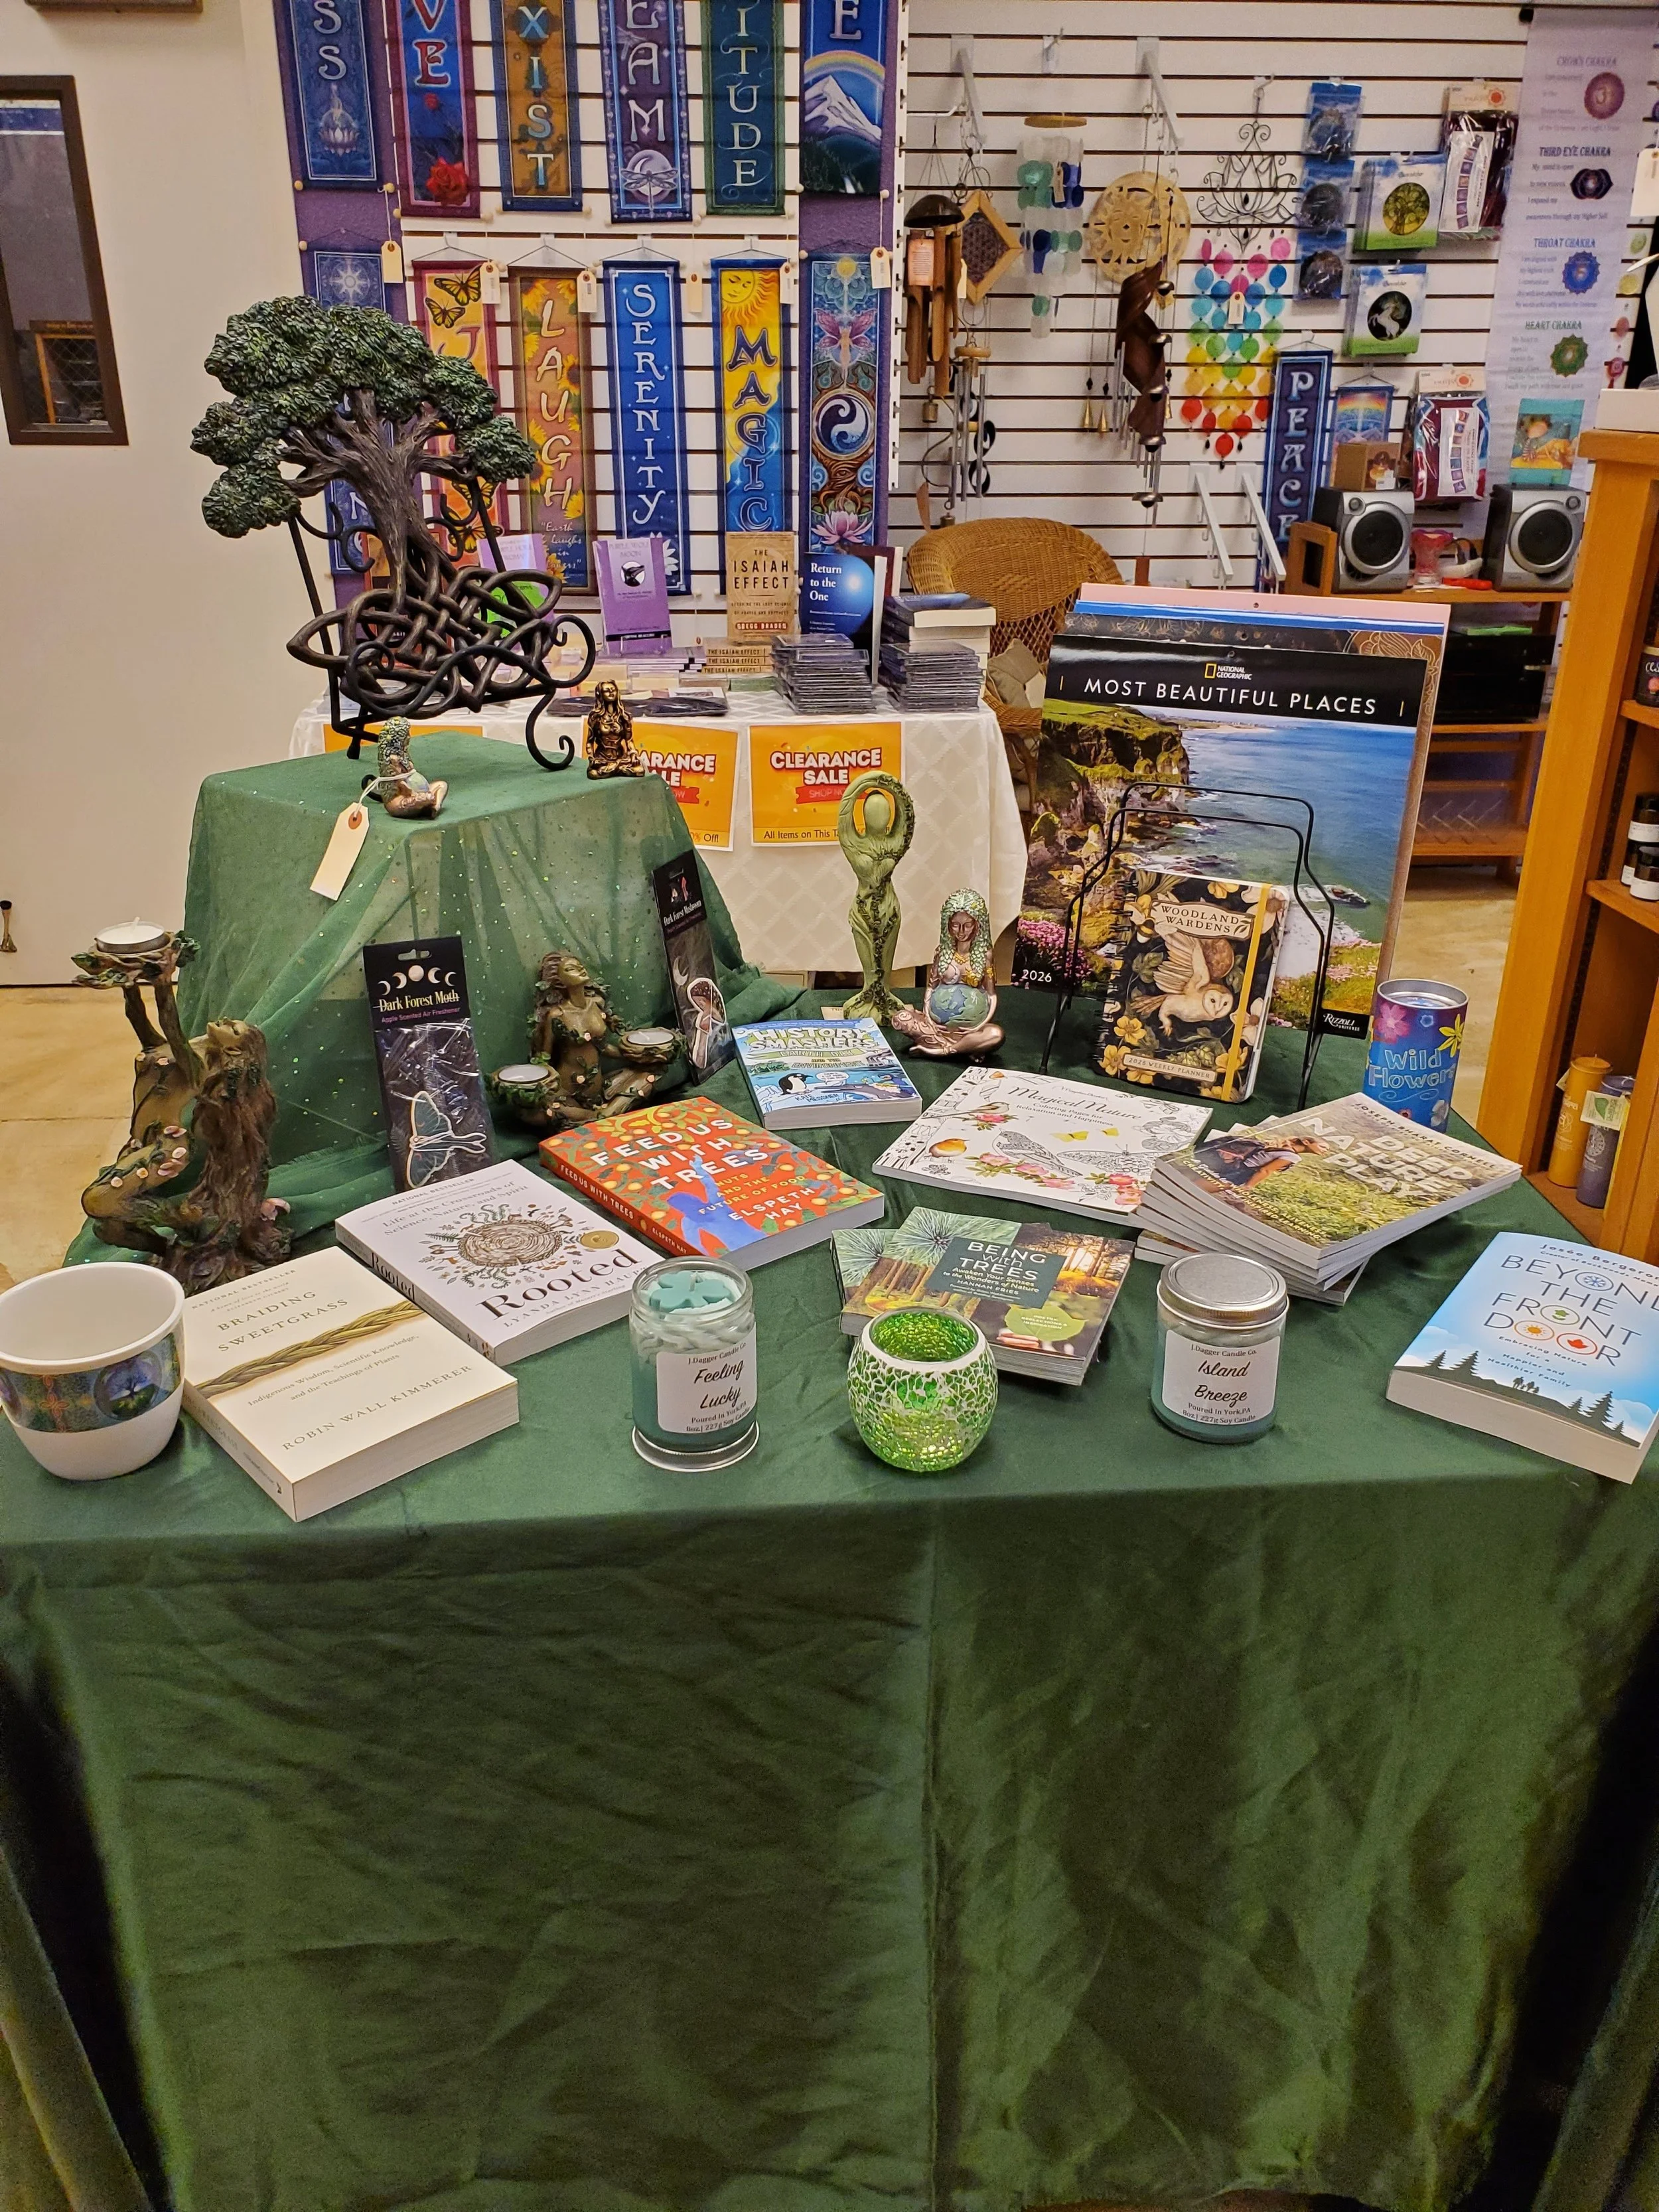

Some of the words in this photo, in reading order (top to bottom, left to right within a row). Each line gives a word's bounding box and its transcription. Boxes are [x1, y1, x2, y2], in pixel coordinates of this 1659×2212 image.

[518, 6, 554, 187] XIST
[726, 7, 762, 188] ITUDE
[1539, 146, 1562, 157] THIRD
[1563, 145, 1578, 157] EYE
[1580, 146, 1611, 157] CHAKRA
[1534, 238, 1563, 248] THROAT
[1565, 238, 1596, 248] CHAKRA
[1525, 320, 1550, 330] HEART
[1551, 321, 1583, 330] CHAKRA
[536, 299, 575, 510] LAUGH
[626, 283, 666, 525] SERENITY
[725, 325, 778, 532] MAGIC
[733, 560, 789, 573] ISAIAH
[810, 562, 842, 574] Return
[733, 577, 789, 589] EFFECT
[822, 577, 836, 587] the
[810, 590, 829, 601] One
[1216, 666, 1246, 674] NATIONAL
[1216, 672, 1253, 680] GEOGRAPHIC
[1084, 678, 1147, 698] MOST
[1156, 682, 1278, 708] BEAUTIFUL
[1289, 692, 1377, 715] PLACES
[770, 747, 883, 769] CLEARANCE
[804, 769, 849, 786] SALE
[809, 788, 832, 798] SHOP
[764, 830, 775, 839] All
[778, 830, 799, 839] Items
[814, 829, 830, 838] This
[1161, 905, 1240, 925] WOODLAND
[1165, 915, 1231, 933] WARDENS
[1022, 969, 1052, 984] 2026
[378, 996, 403, 1012] Dark
[404, 994, 433, 1009] Forest
[435, 989, 461, 1004] Moth
[399, 1012, 422, 1021] Scented
[749, 1038, 876, 1051] SMASHERS
[752, 1027, 867, 1041] HISTORY
[830, 1049, 855, 1058] DAY
[1384, 1049, 1442, 1070] Wild
[1129, 1057, 1146, 1066] 2026
[1148, 1061, 1175, 1071] WEEKLY
[1177, 1067, 1210, 1078] PLANNER
[1007, 1086, 1086, 1108] Magical
[1085, 1100, 1143, 1120] Nature
[1033, 1102, 1068, 1113] Coloring
[1068, 1109, 1090, 1118] Pages
[1016, 1104, 1056, 1116] Relaxation
[1073, 1114, 1114, 1127] Happiness
[1355, 1102, 1395, 1126] JOSEPH
[1398, 1126, 1442, 1145] BHARAT
[590, 1132, 684, 1167] FEED
[685, 1119, 734, 1136] US
[638, 1137, 733, 1171] WITH
[1299, 1117, 1455, 1193] NATURE
[1369, 1135, 1473, 1180] DEEP
[650, 1148, 768, 1191] TREES
[714, 1173, 749, 1187] NUTS
[560, 1165, 578, 1181] FEED
[579, 1176, 589, 1188] US
[589, 1186, 609, 1203] WITH
[610, 1198, 634, 1220] TREES
[698, 1193, 751, 1215] FUTURE
[751, 1187, 769, 1196] OF
[770, 1175, 806, 1189] FOOD
[716, 1185, 742, 1198] AND
[744, 1176, 770, 1188] THE
[476, 1195, 497, 1205] and
[728, 1187, 816, 1221] ELSPETH
[382, 1215, 407, 1228] Life
[408, 1211, 420, 1219] at
[421, 1203, 439, 1215] the
[764, 1202, 804, 1220] HAY
[967, 1241, 1047, 1264] BEING
[982, 1253, 1023, 1268] with
[1540, 1251, 1569, 1260] Creator
[370, 1252, 416, 1301] Rooted
[952, 1267, 984, 1278] Awaken
[985, 1272, 1005, 1281] Your
[1005, 1277, 1035, 1288] Senses
[960, 1257, 1039, 1280] TREES
[475, 1248, 643, 1321] Rooted
[956, 1279, 993, 1290] HANNAH
[964, 1274, 999, 1286] Wonders
[1010, 1282, 1040, 1293] Nature
[1540, 1280, 1619, 1317] THE
[217, 1291, 317, 1331] BRAIDING
[1491, 1292, 1642, 1346] FRONT
[218, 1298, 348, 1352] SWEETGRASS
[1482, 1311, 1621, 1366] DOOR
[687, 1355, 719, 1365] J.Dagger
[1190, 1343, 1220, 1356] J.Dagger
[1498, 1336, 1550, 1355] Embracing
[1553, 1351, 1588, 1367] Nature
[693, 1359, 745, 1384] Feeling
[1197, 1360, 1252, 1377] Island
[1486, 1357, 1535, 1375] Healthier
[1538, 1373, 1571, 1388] Family
[1502, 1353, 1545, 1372] Happier
[1546, 1367, 1566, 1377] and
[290, 1390, 307, 1401] and
[307, 1383, 321, 1394] the
[321, 1368, 364, 1387] Teachings
[364, 1362, 374, 1371] of
[374, 1353, 400, 1368] Plants
[699, 1385, 742, 1410] Lucky
[1194, 1384, 1248, 1408] Breeze
[281, 1422, 336, 1451] ROBIN
[339, 1401, 388, 1424] WALL
[389, 1364, 473, 1403] KIMMERER
[1188, 1402, 1213, 1414] Poured
[691, 1414, 717, 1424] Poured
[723, 1417, 735, 1428] Soy
[1233, 1414, 1256, 1423] Candle
